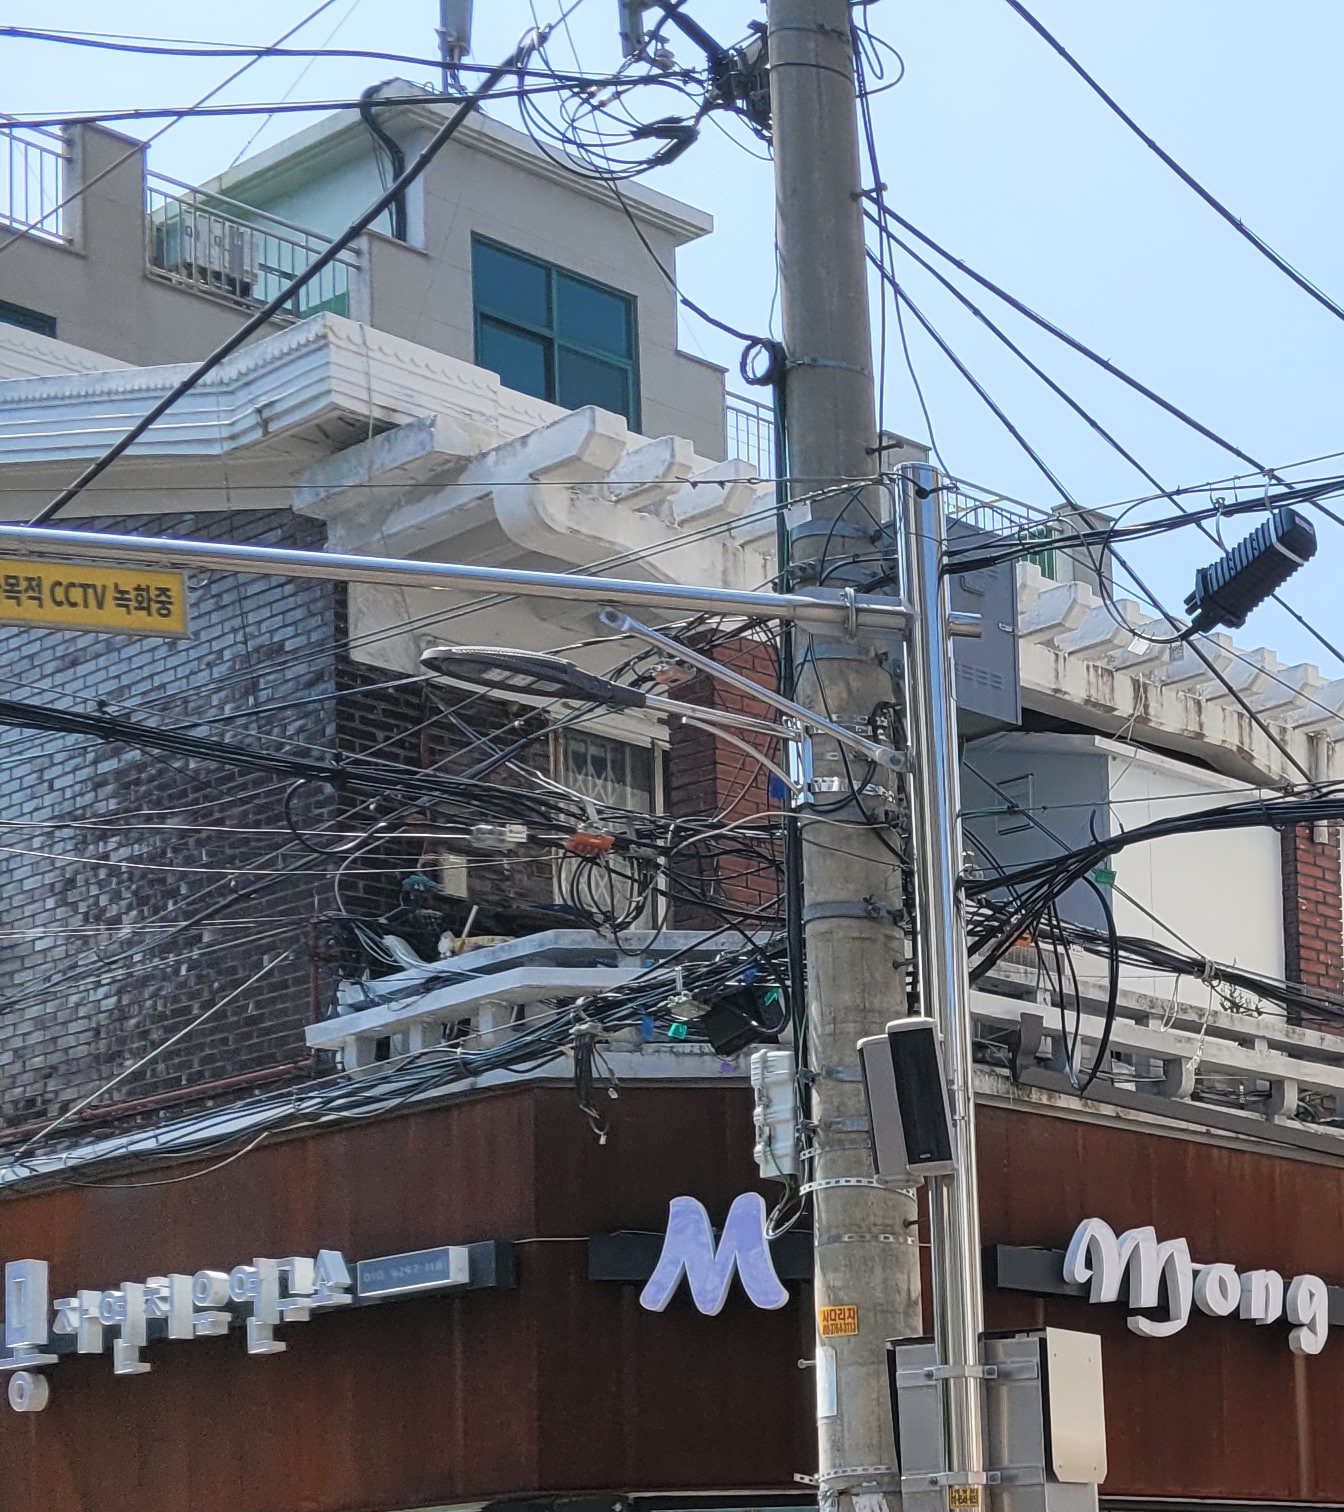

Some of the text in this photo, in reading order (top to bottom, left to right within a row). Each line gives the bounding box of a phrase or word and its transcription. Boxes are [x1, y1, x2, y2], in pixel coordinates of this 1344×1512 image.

[0, 574, 174, 619] 목적 CCTV 녹화중
[639, 1191, 790, 1316] M
